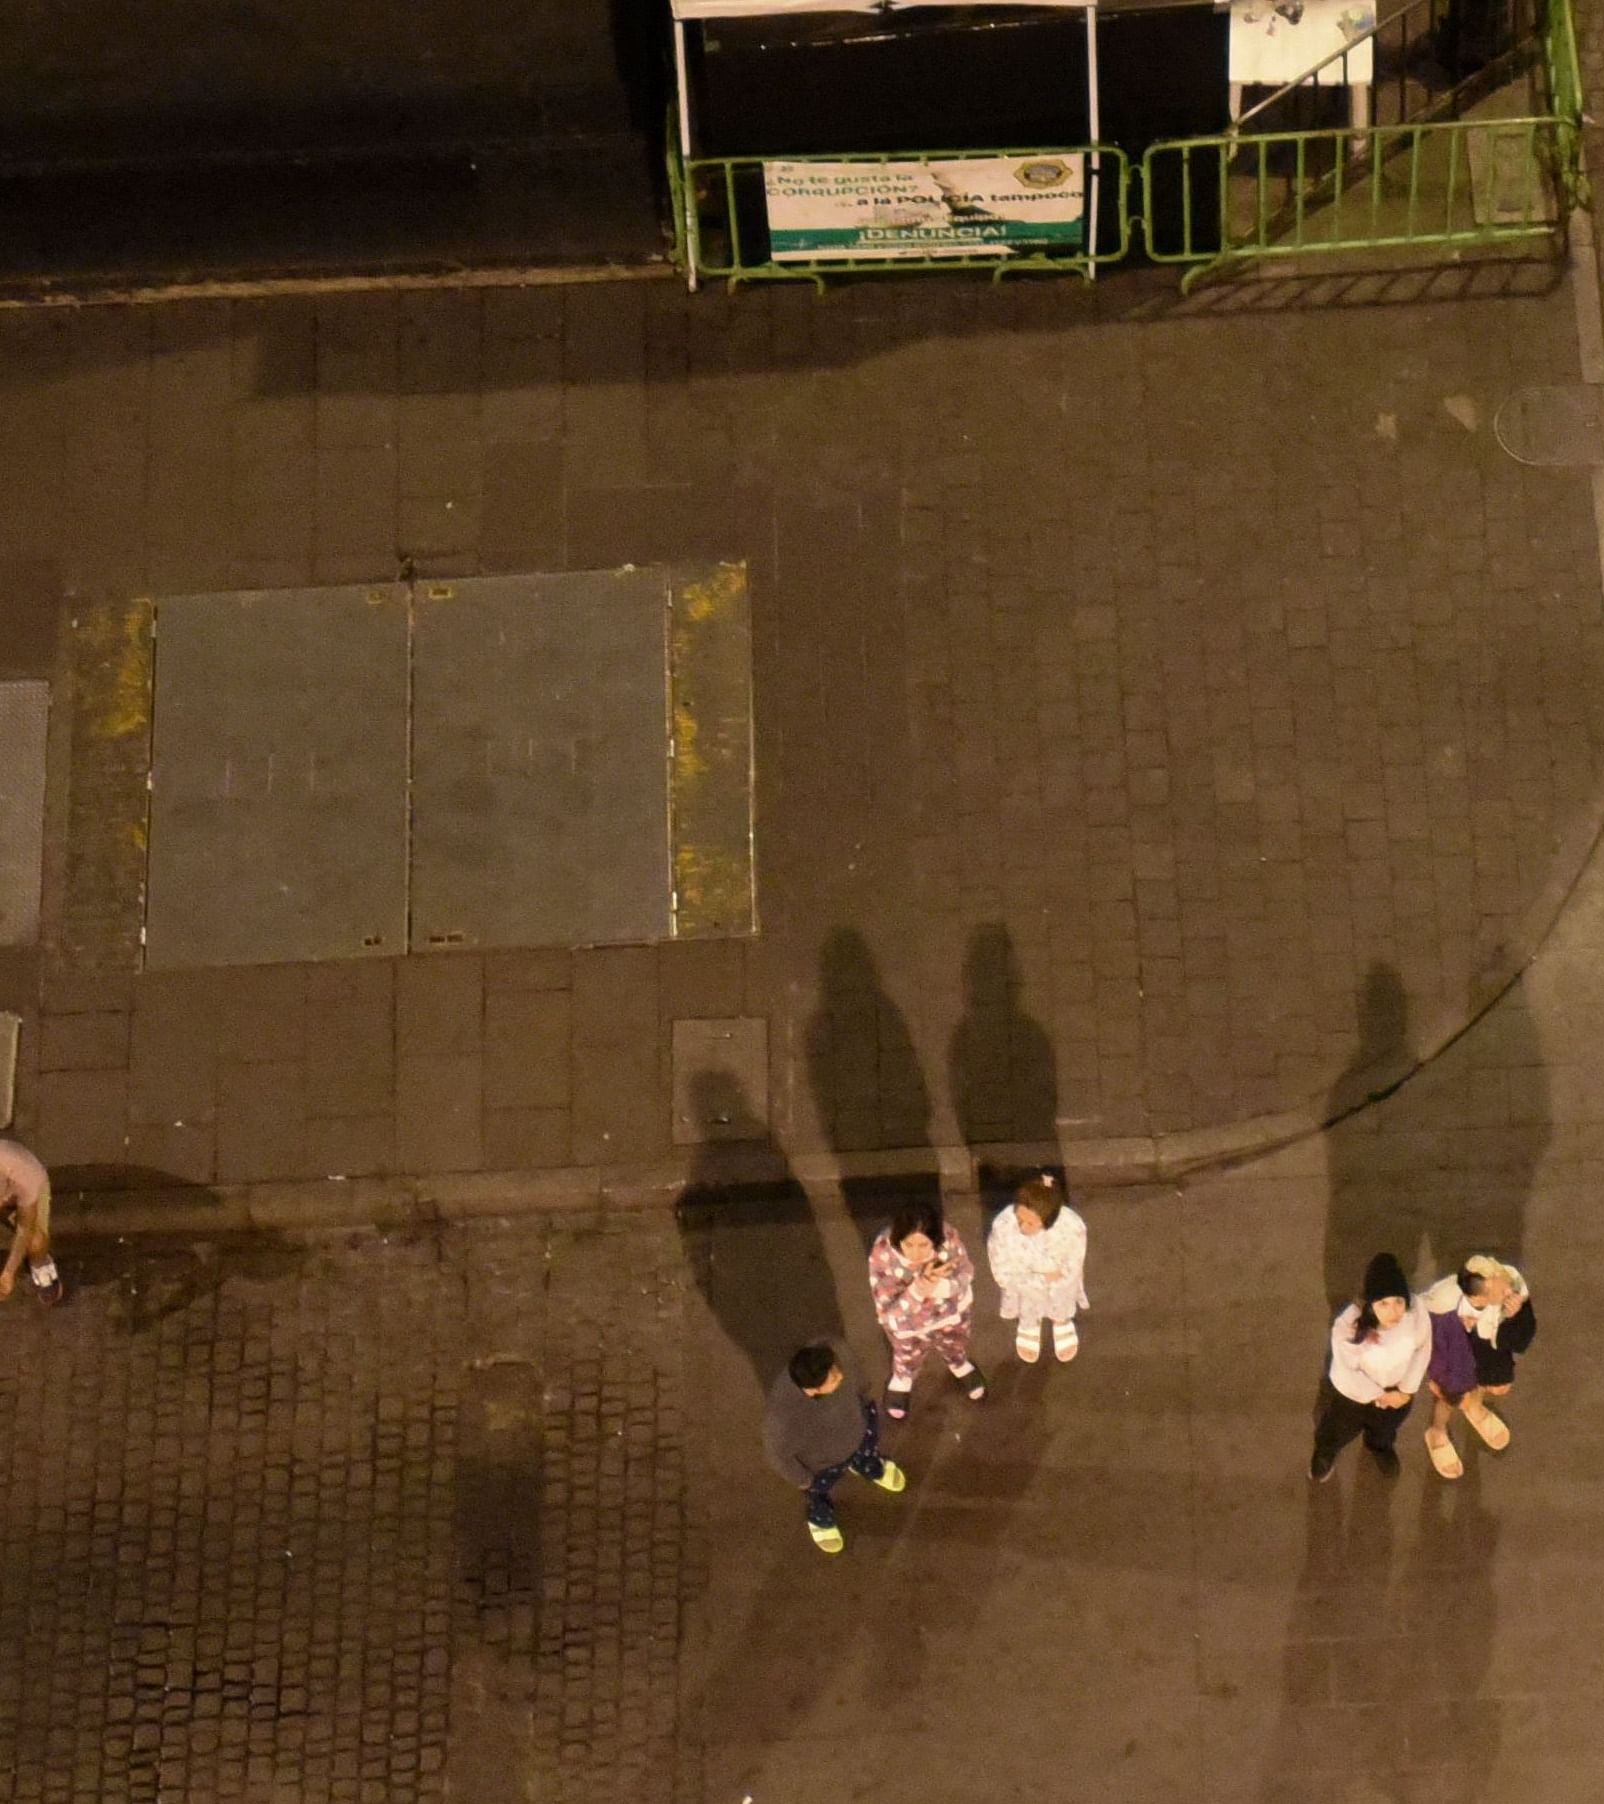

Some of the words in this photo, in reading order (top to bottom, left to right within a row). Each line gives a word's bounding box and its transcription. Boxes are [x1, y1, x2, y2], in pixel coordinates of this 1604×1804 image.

[808, 175, 828, 185] te
[834, 175, 891, 185] gusta
[991, 191, 1082, 202] tampoco
[859, 224, 1007, 241] ¡DENUNCIA!
